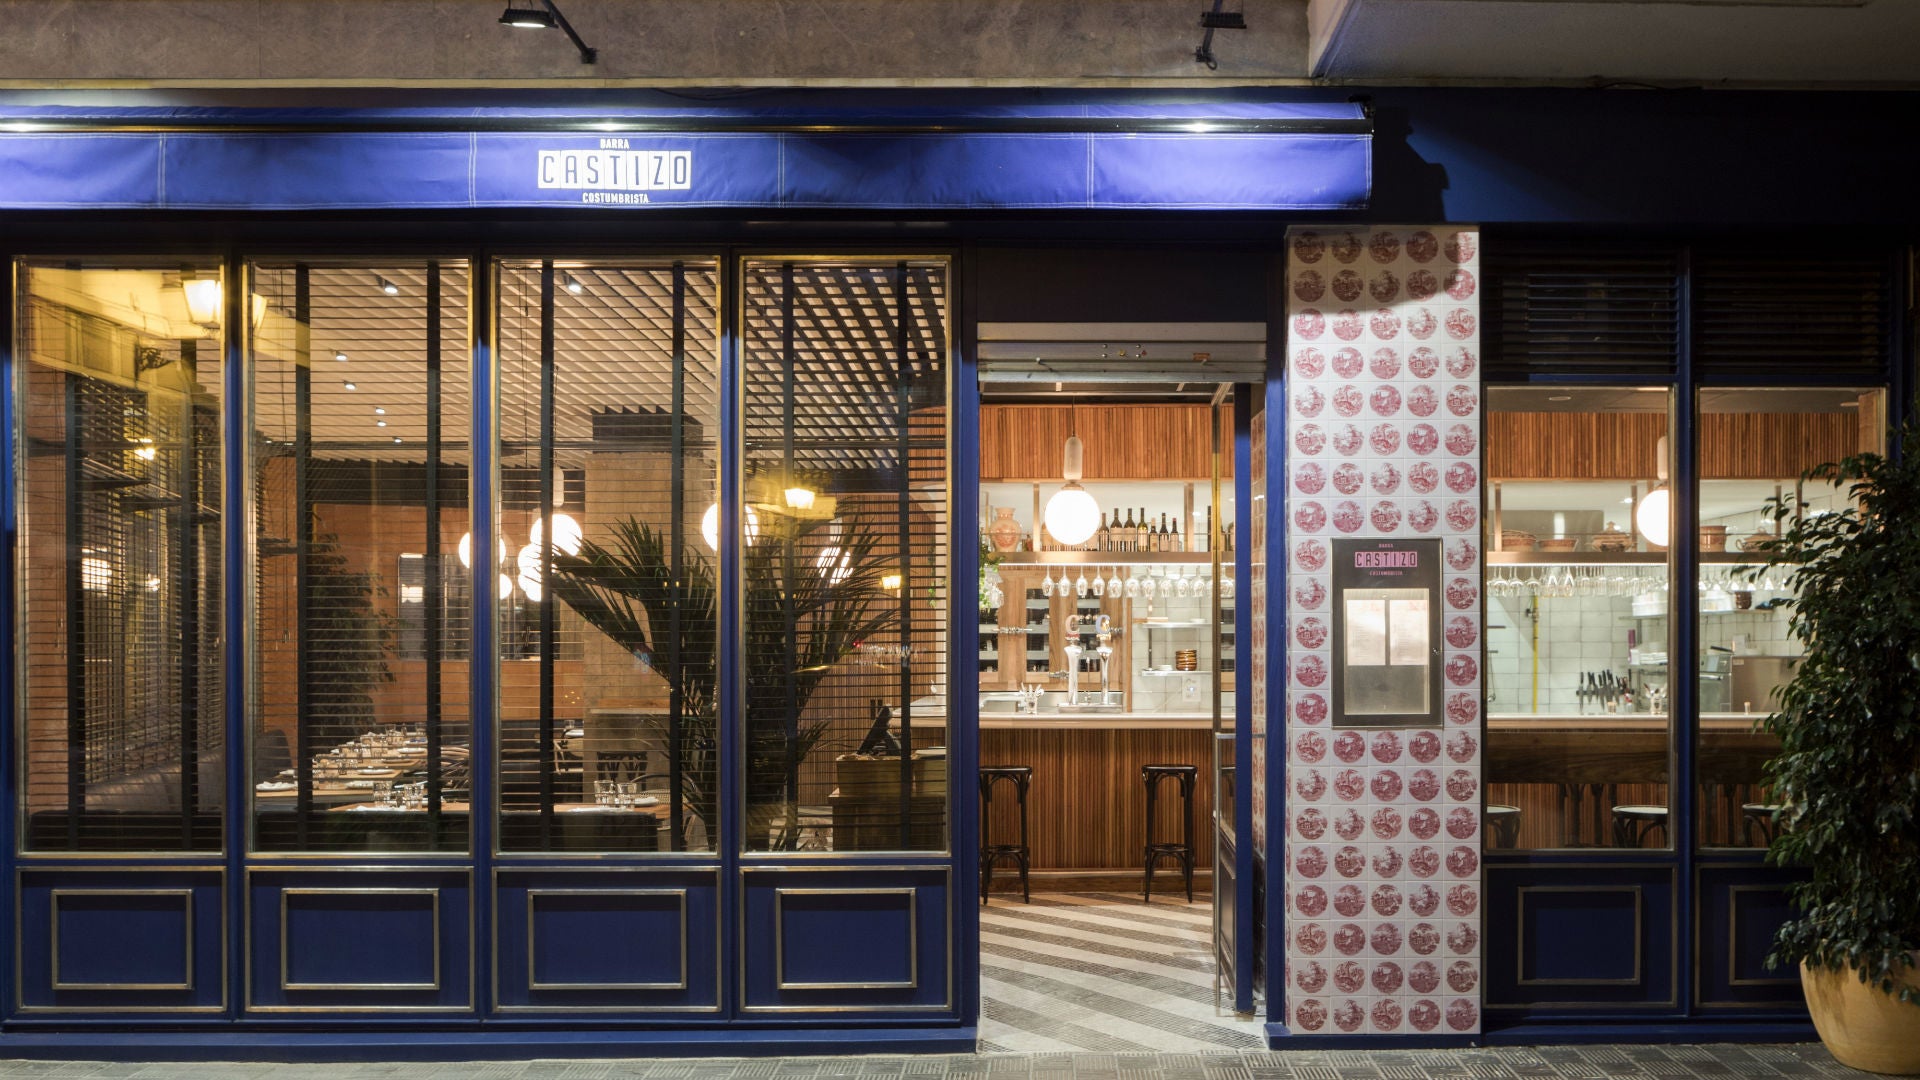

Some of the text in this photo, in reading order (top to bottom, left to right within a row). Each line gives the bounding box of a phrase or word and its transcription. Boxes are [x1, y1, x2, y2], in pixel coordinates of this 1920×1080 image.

[599, 138, 630, 149] BARRA
[542, 154, 688, 187] CASTIZO
[582, 192, 649, 203] COSTUMBRISTA
[1356, 552, 1416, 567] CASTIZO
